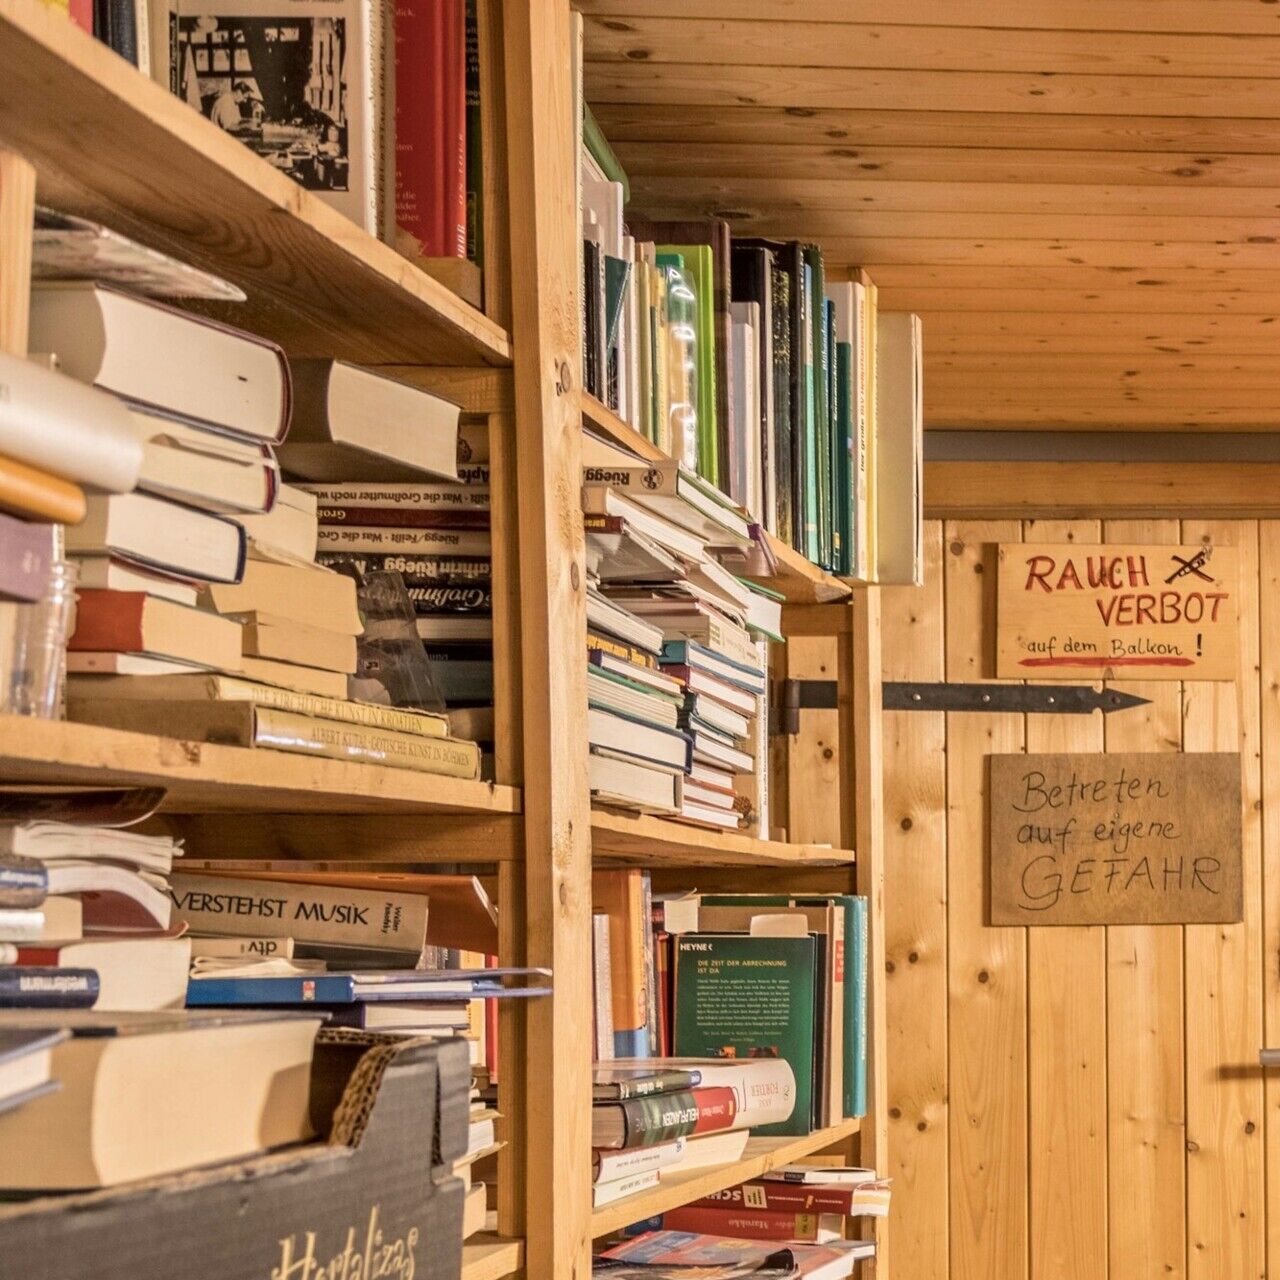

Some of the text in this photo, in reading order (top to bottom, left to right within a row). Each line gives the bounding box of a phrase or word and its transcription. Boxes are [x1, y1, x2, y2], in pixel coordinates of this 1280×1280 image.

[329, 489, 357, 502] noch
[359, 490, 421, 504] Großmutter
[422, 491, 441, 504] die
[442, 491, 463, 504] Was
[318, 530, 340, 542] Gro
[342, 531, 360, 543] die
[361, 532, 382, 543] Was
[384, 556, 438, 579] Rüegg
[438, 559, 493, 578] athrin
[1025, 555, 1149, 593] RAUCH
[1096, 592, 1229, 627] VERBOT
[1027, 636, 1058, 658] auf
[1063, 632, 1097, 653] dem
[1109, 637, 1182, 659] Balkon
[335, 702, 366, 725] KUNST
[1013, 769, 1169, 812] Betreten
[1017, 812, 1181, 854] auf eigene
[1018, 855, 1221, 911] GEFAHR
[170, 889, 370, 926] VERSTEHST MUSIK
[247, 941, 278, 956] dtv
[680, 943, 708, 952] HEYNE
